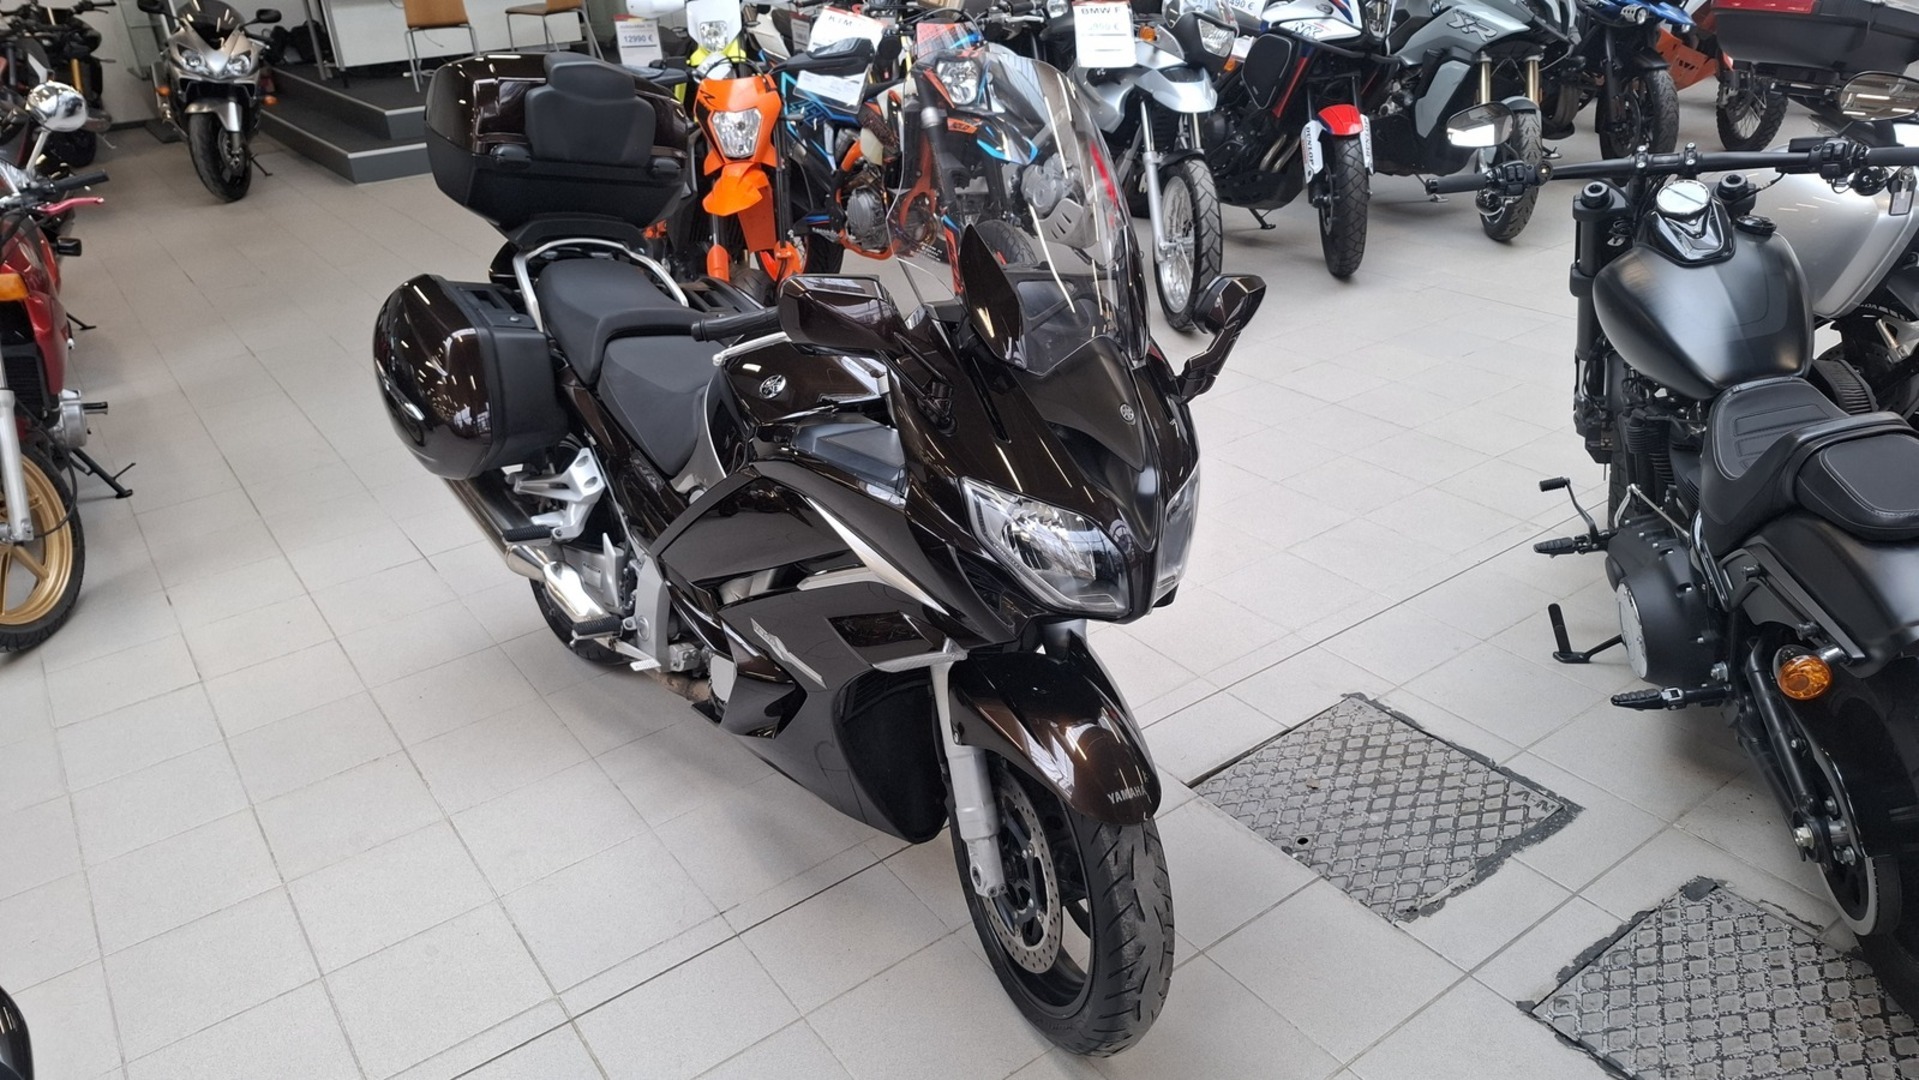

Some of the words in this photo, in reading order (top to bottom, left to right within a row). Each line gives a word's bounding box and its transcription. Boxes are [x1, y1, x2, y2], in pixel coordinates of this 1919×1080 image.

[1081, 7, 1111, 15] BMW
[1446, 11, 1498, 43] XR
[623, 34, 647, 43] 12990
[1305, 126, 1315, 166] DUNLOP
[1106, 784, 1148, 805] YAMAHA
